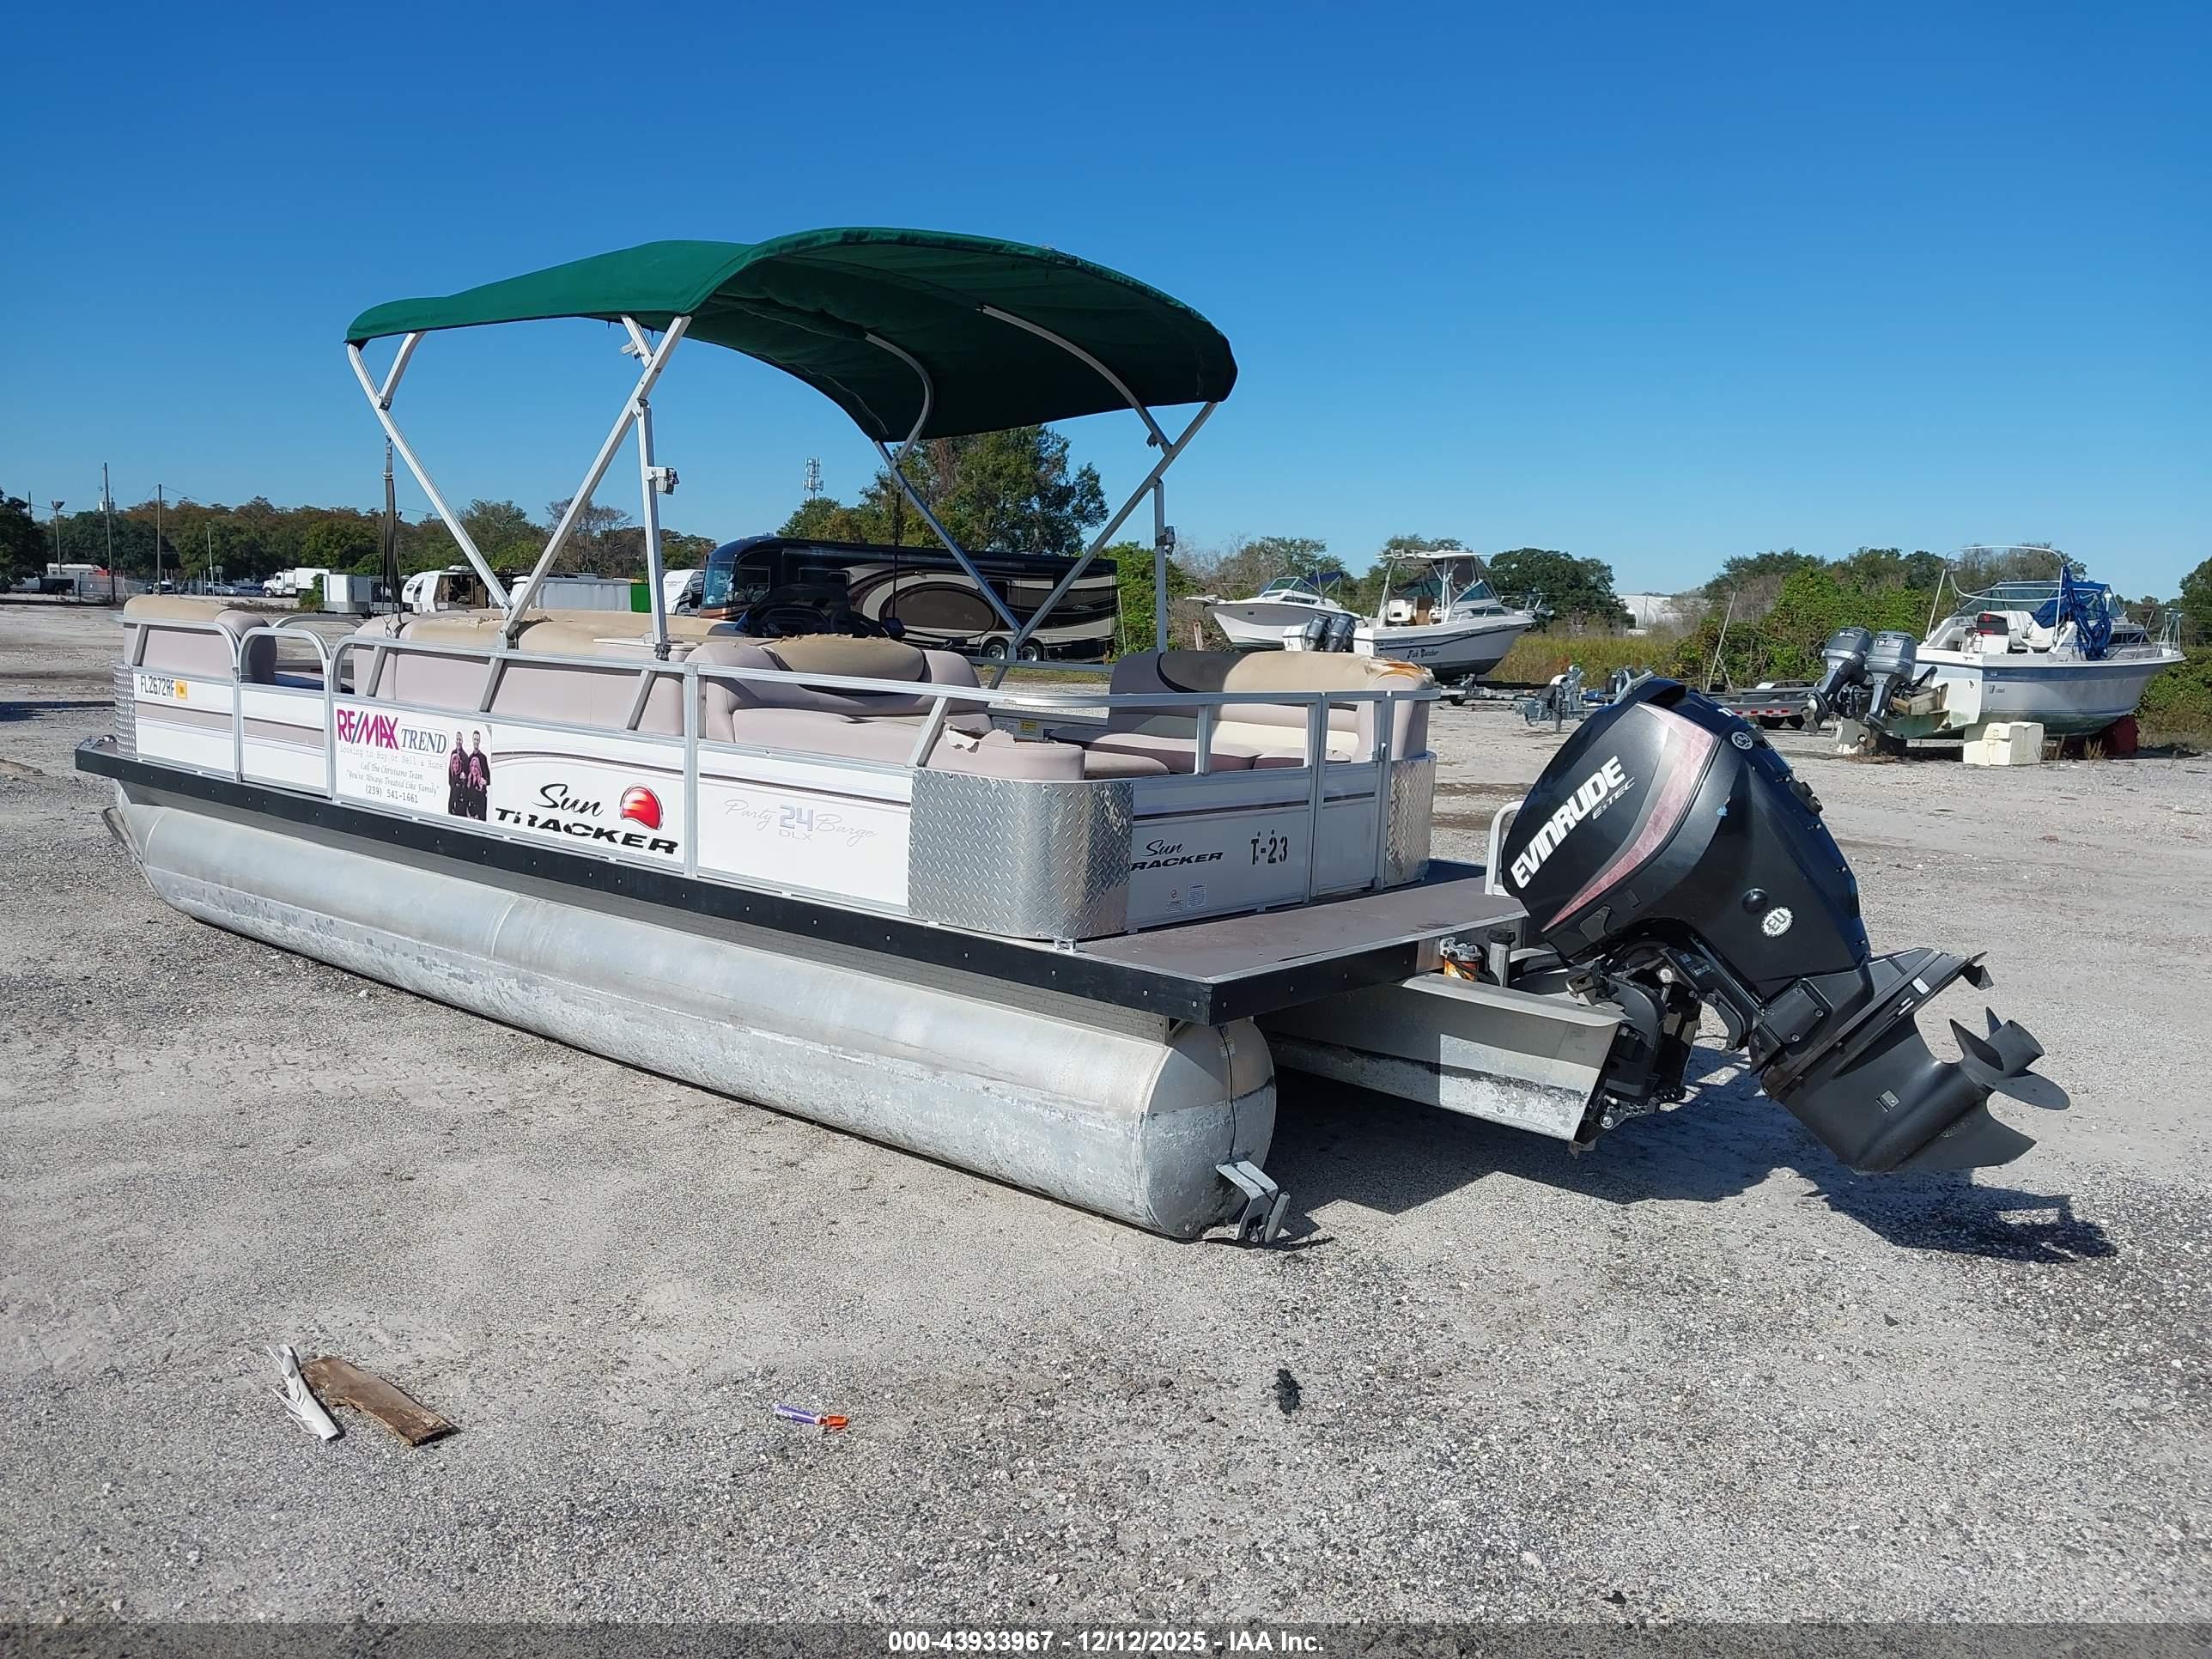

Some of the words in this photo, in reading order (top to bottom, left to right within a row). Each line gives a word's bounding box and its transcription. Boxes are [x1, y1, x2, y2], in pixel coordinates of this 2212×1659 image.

[337, 708, 399, 750] RE/MAX
[400, 728, 447, 754] TREND
[340, 744, 363, 758] Looking
[366, 749, 374, 757] to
[377, 750, 387, 762] Buy
[401, 755, 416, 766] Sell
[361, 762, 371, 771] Call
[409, 770, 423, 781] Team
[366, 784, 382, 798] (239)
[386, 789, 419, 804] 541-1661
[384, 776, 404, 789] Treated
[404, 781, 416, 791] Like
[532, 783, 604, 817] Sun
[495, 807, 679, 855] TRACKER
[724, 799, 776, 830] Party
[780, 805, 813, 832] 24
[816, 813, 878, 847] Barge
[1510, 755, 1626, 889] EVINRUDE
[779, 829, 812, 842] DLX
[1140, 839, 1184, 857] Sun
[1130, 852, 1223, 872] RACKER
